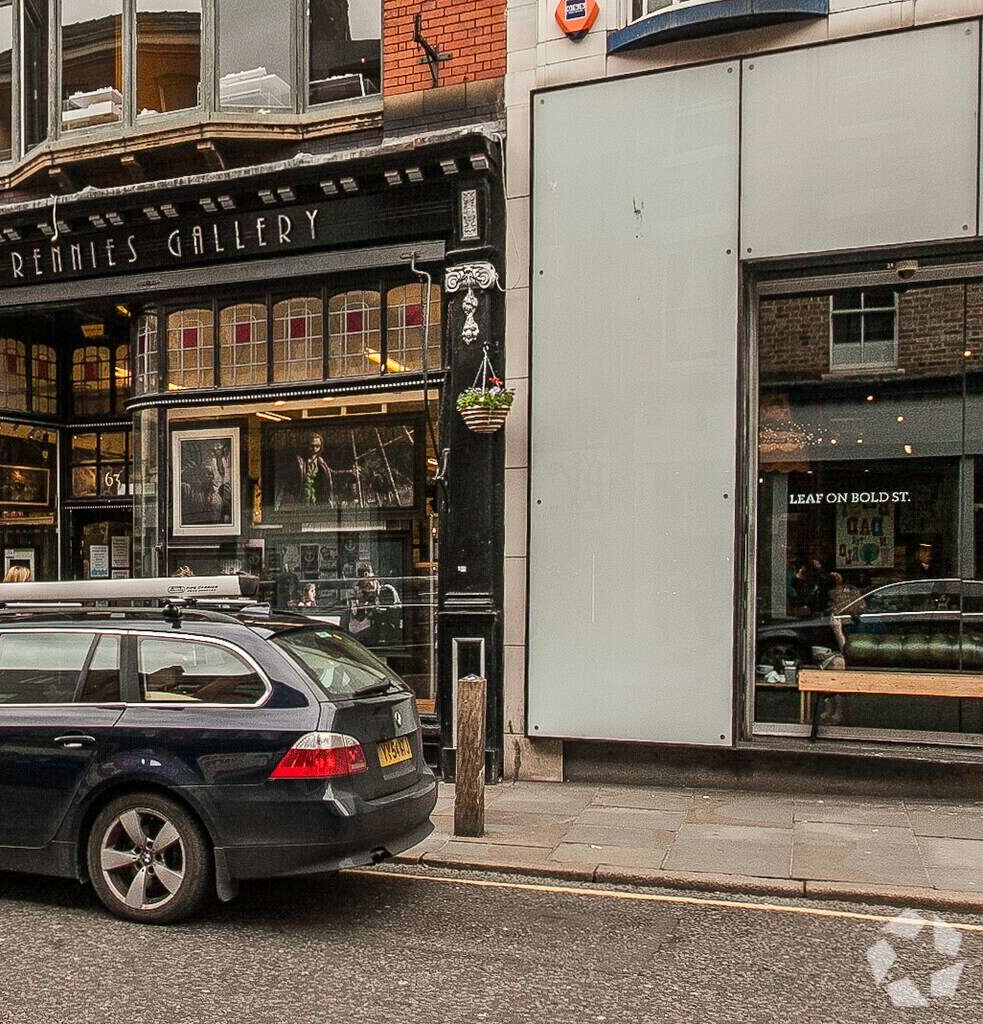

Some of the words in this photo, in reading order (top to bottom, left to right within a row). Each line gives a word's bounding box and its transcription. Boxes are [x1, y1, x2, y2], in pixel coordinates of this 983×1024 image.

[10, 234, 138, 279] RENNIES
[167, 209, 319, 258] GALLERY
[105, 472, 121, 487] 63
[789, 493, 824, 505] LEAF
[826, 492, 848, 503] ON
[851, 491, 890, 503] BOLD
[891, 491, 911, 502] ST.
